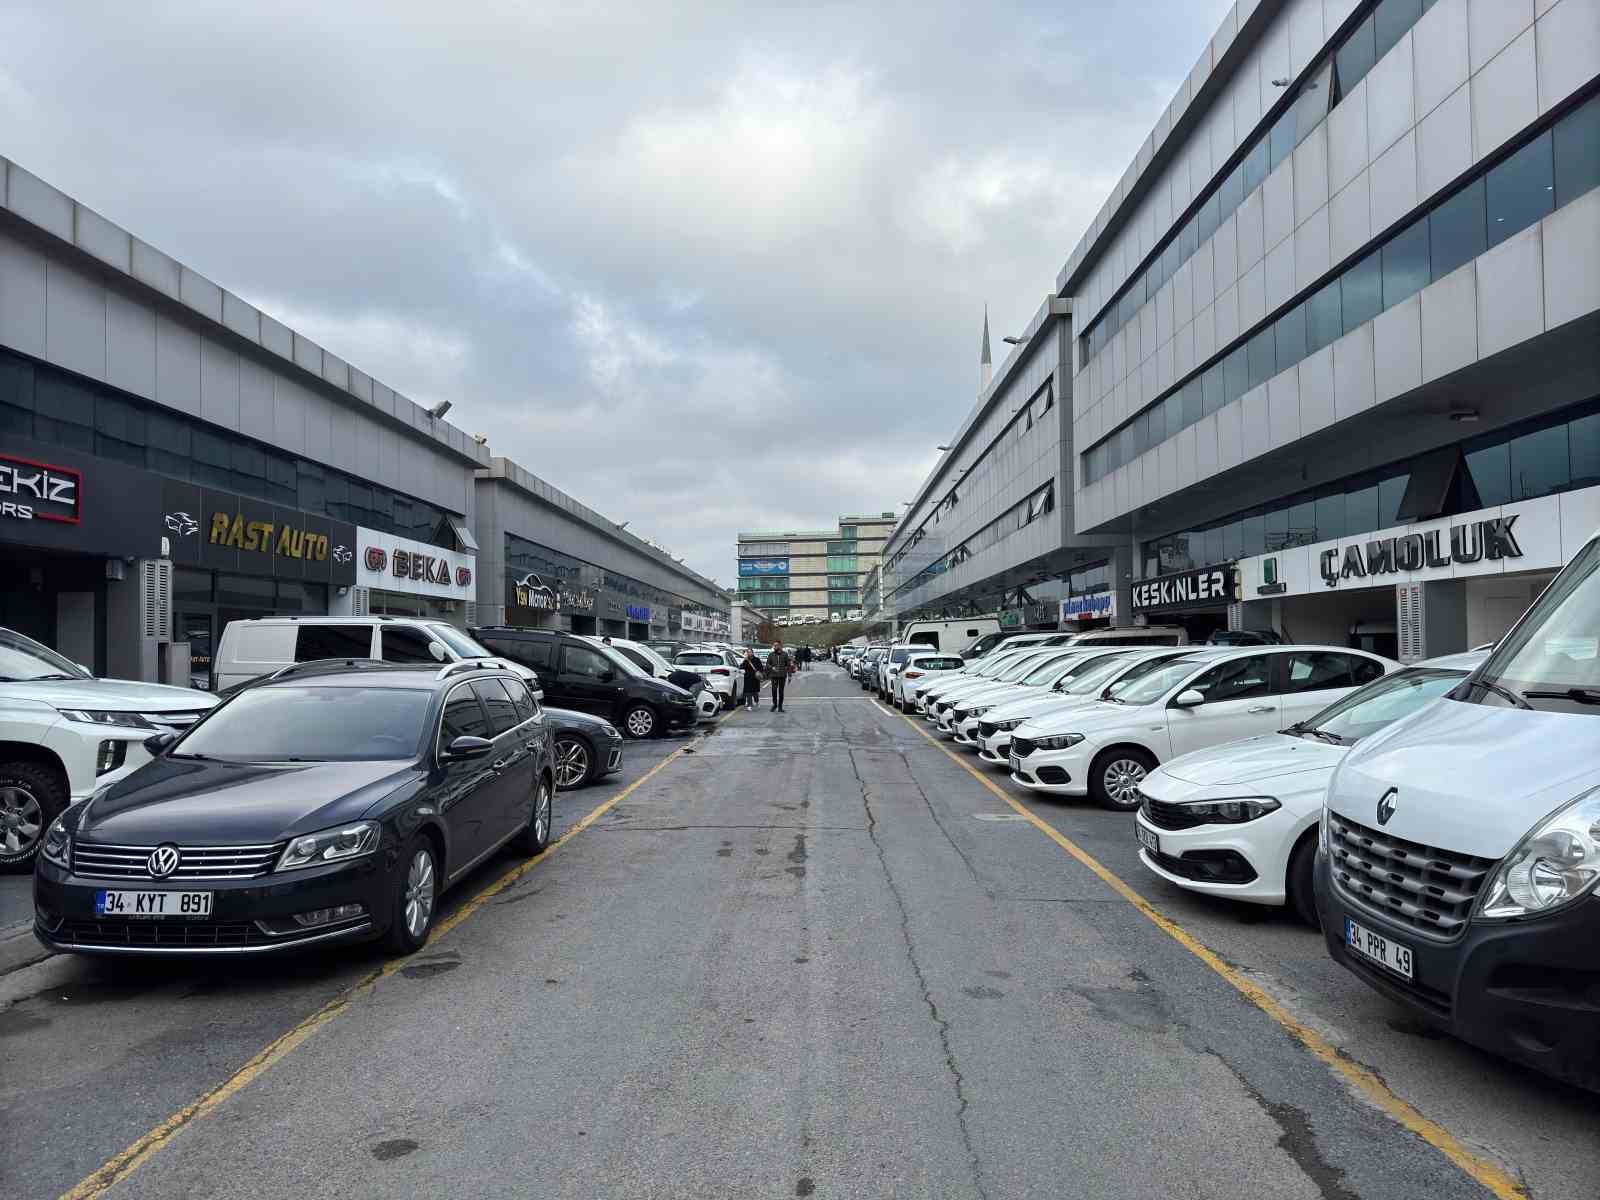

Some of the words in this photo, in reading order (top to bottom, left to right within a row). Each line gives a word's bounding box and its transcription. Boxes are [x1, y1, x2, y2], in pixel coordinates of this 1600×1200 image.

[209, 512, 273, 552] RAST
[276, 525, 328, 560] AUTO
[1320, 515, 1523, 587] ÇAMOLUK
[106, 893, 124, 913] 34
[136, 893, 167, 913] KYT
[180, 893, 209, 913] 891
[1367, 933, 1386, 961] PPR
[1396, 946, 1410, 974] 49
